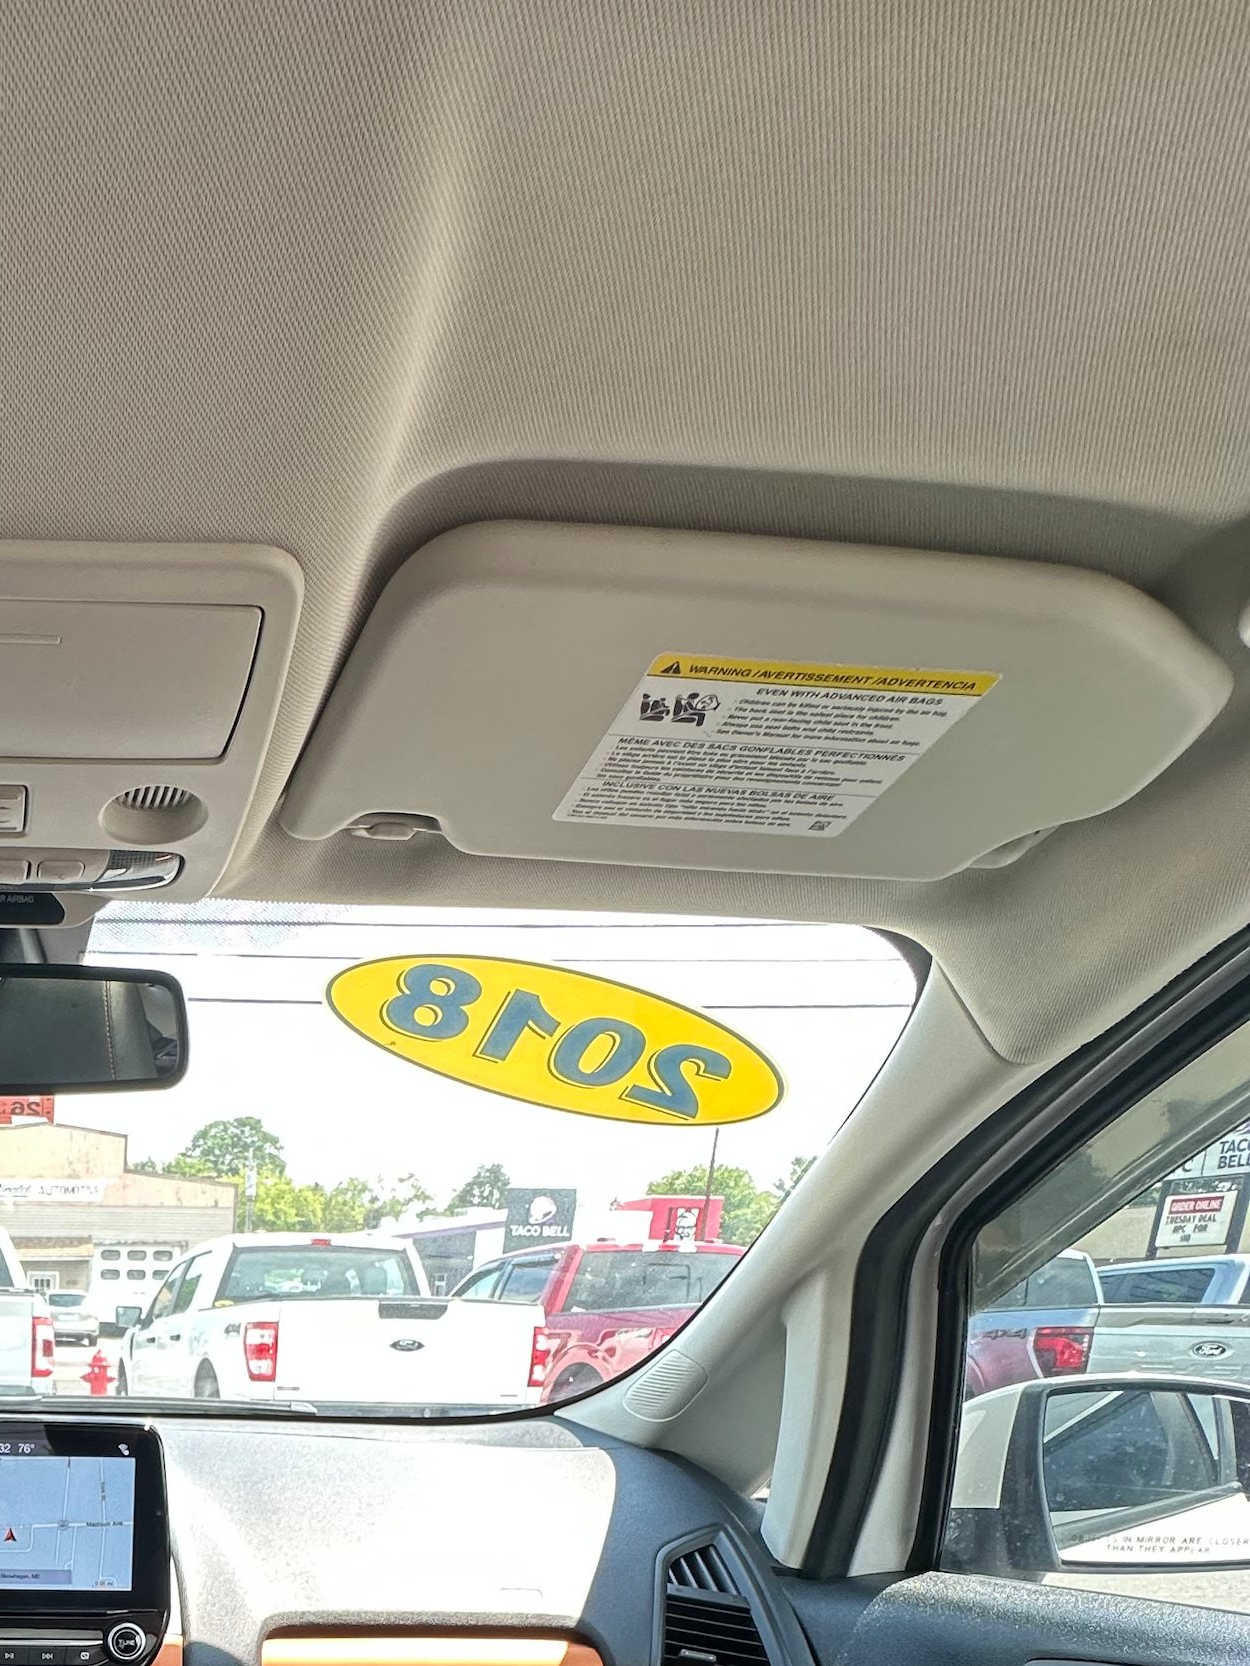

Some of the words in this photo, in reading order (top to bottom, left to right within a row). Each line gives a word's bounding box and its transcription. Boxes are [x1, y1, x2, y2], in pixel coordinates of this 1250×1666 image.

[689, 664, 751, 677] WARNING
[756, 688, 788, 696] EVEN
[790, 690, 821, 698] WITH
[820, 692, 886, 702] ADVANCED
[888, 694, 906, 704] AIR
[908, 696, 944, 706] BAGS
[652, 740, 682, 748] AVEC
[706, 742, 736, 750] SACS
[658, 784, 682, 792] CON
[6, 894, 35, 904] AIRBAG
[1219, 1138, 1250, 1154] TAC
[1195, 1198, 1223, 1210] ONLINE
[1166, 1215, 1196, 1225] TUESDAY
[1198, 1214, 1216, 1223] DEAL
[510, 1224, 542, 1236] TACO
[542, 1225, 570, 1237] BELL
[1193, 1224, 1208, 1233] FOR
[18, 1443, 36, 1454] 76°
[1071, 1533, 1118, 1543] OBJETS
[1136, 1536, 1176, 1545] MIRROR
[1181, 1536, 1202, 1545] ARE
[1208, 1538, 1250, 1546] CLOSER
[1106, 1544, 1134, 1552] THAN
[1138, 1545, 1165, 1553] THEY
[1169, 1546, 1210, 1554] APPEAR
[118, 1638, 137, 1648] TUNE
